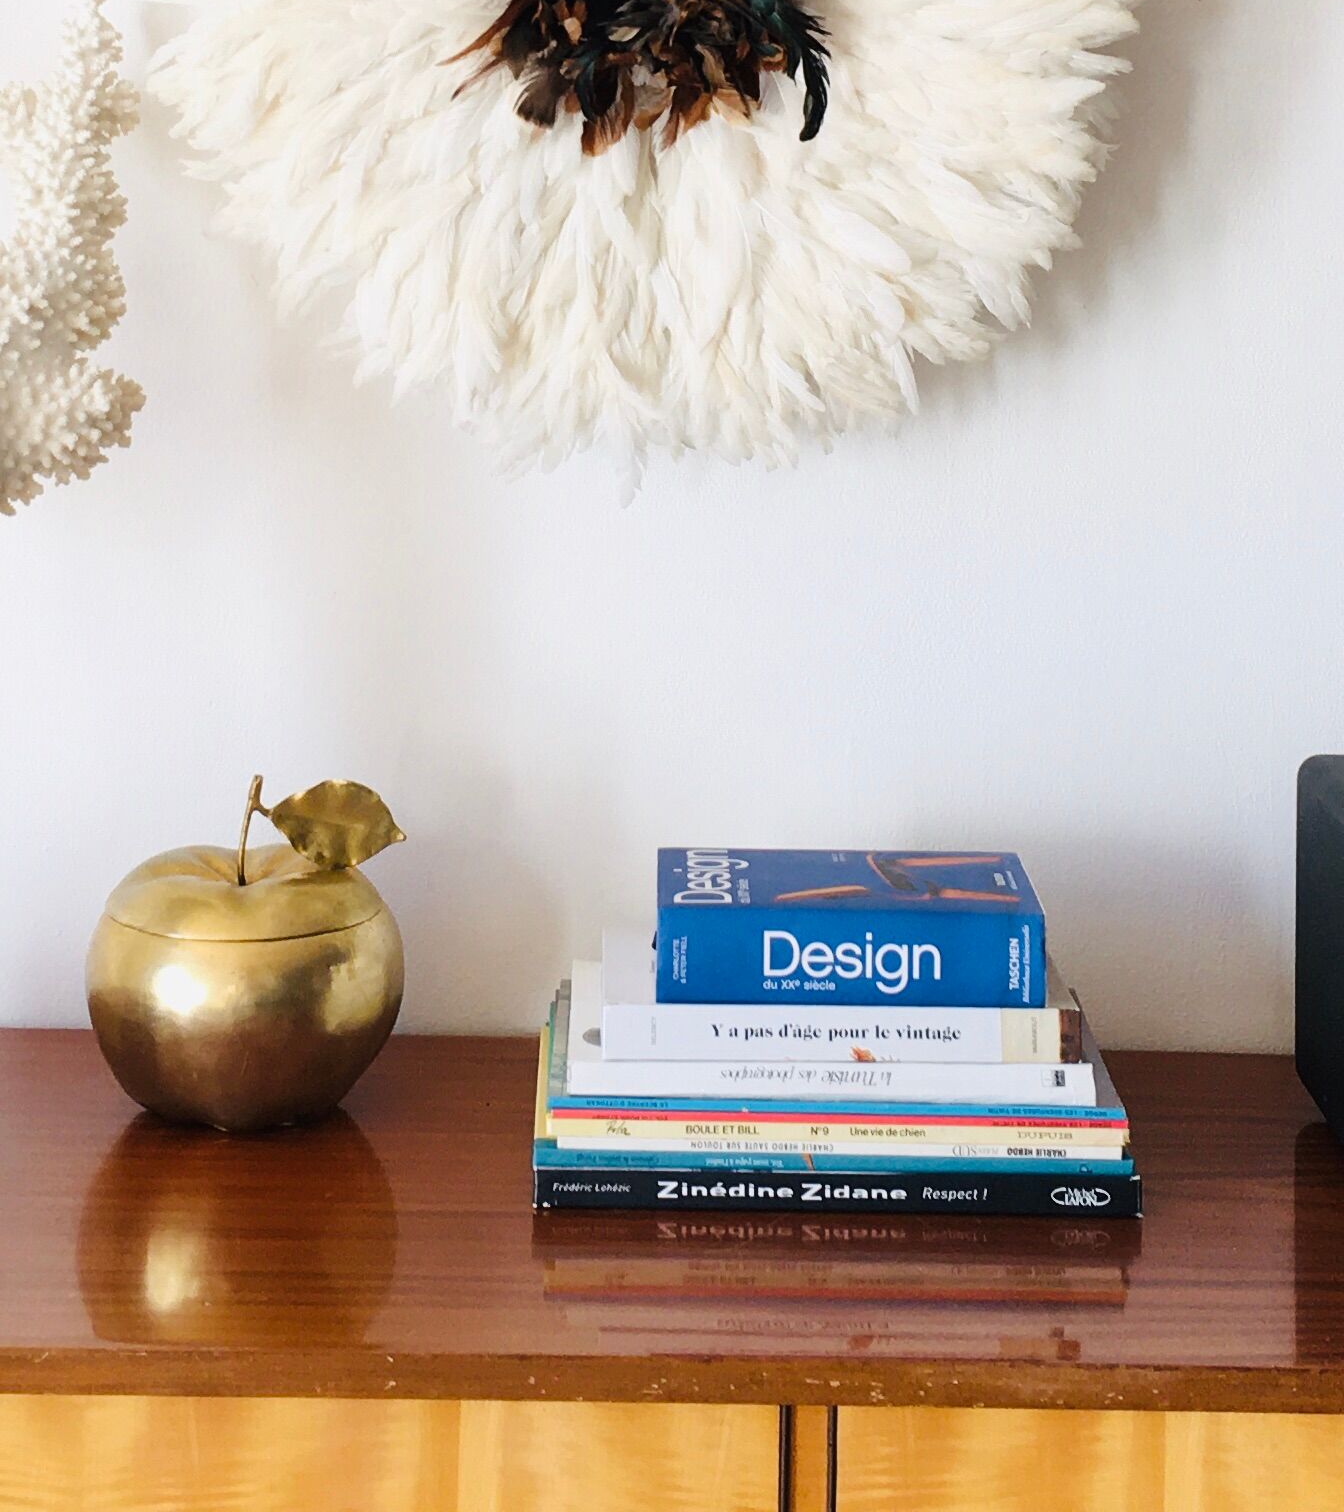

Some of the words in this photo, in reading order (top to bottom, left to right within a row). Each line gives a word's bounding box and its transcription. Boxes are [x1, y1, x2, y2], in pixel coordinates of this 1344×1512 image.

[673, 849, 749, 903] Design
[763, 929, 941, 994] Design
[1009, 937, 1019, 990] TASCHEN
[763, 979, 778, 990] du
[803, 979, 836, 991] siècle
[711, 1023, 723, 1038] Y
[728, 1027, 738, 1038] a
[744, 1027, 773, 1041] pas
[778, 1023, 822, 1041] d'âge
[828, 1027, 869, 1042] pour
[875, 1024, 890, 1039] le
[896, 1024, 961, 1042] vintage
[685, 1125, 720, 1135] BOULE
[722, 1125, 735, 1135] ET
[737, 1125, 759, 1136] BILL
[850, 1127, 869, 1137] Une
[870, 1127, 883, 1137] vie
[883, 1127, 898, 1137] de
[899, 1127, 926, 1137] chien
[690, 1141, 722, 1149] TOULON
[726, 1141, 741, 1149] SUR
[745, 1142, 768, 1150] SAUTE
[772, 1142, 798, 1151] HEBDO
[802, 1143, 834, 1152] CHARLIE
[1007, 1147, 1033, 1156] HEBDO
[1036, 1147, 1067, 1157] CHARLIE
[552, 1182, 593, 1192] Frédéric
[657, 1180, 794, 1199] Zinédine
[801, 1182, 908, 1201] Zidane
[922, 1186, 979, 1201] Respect
